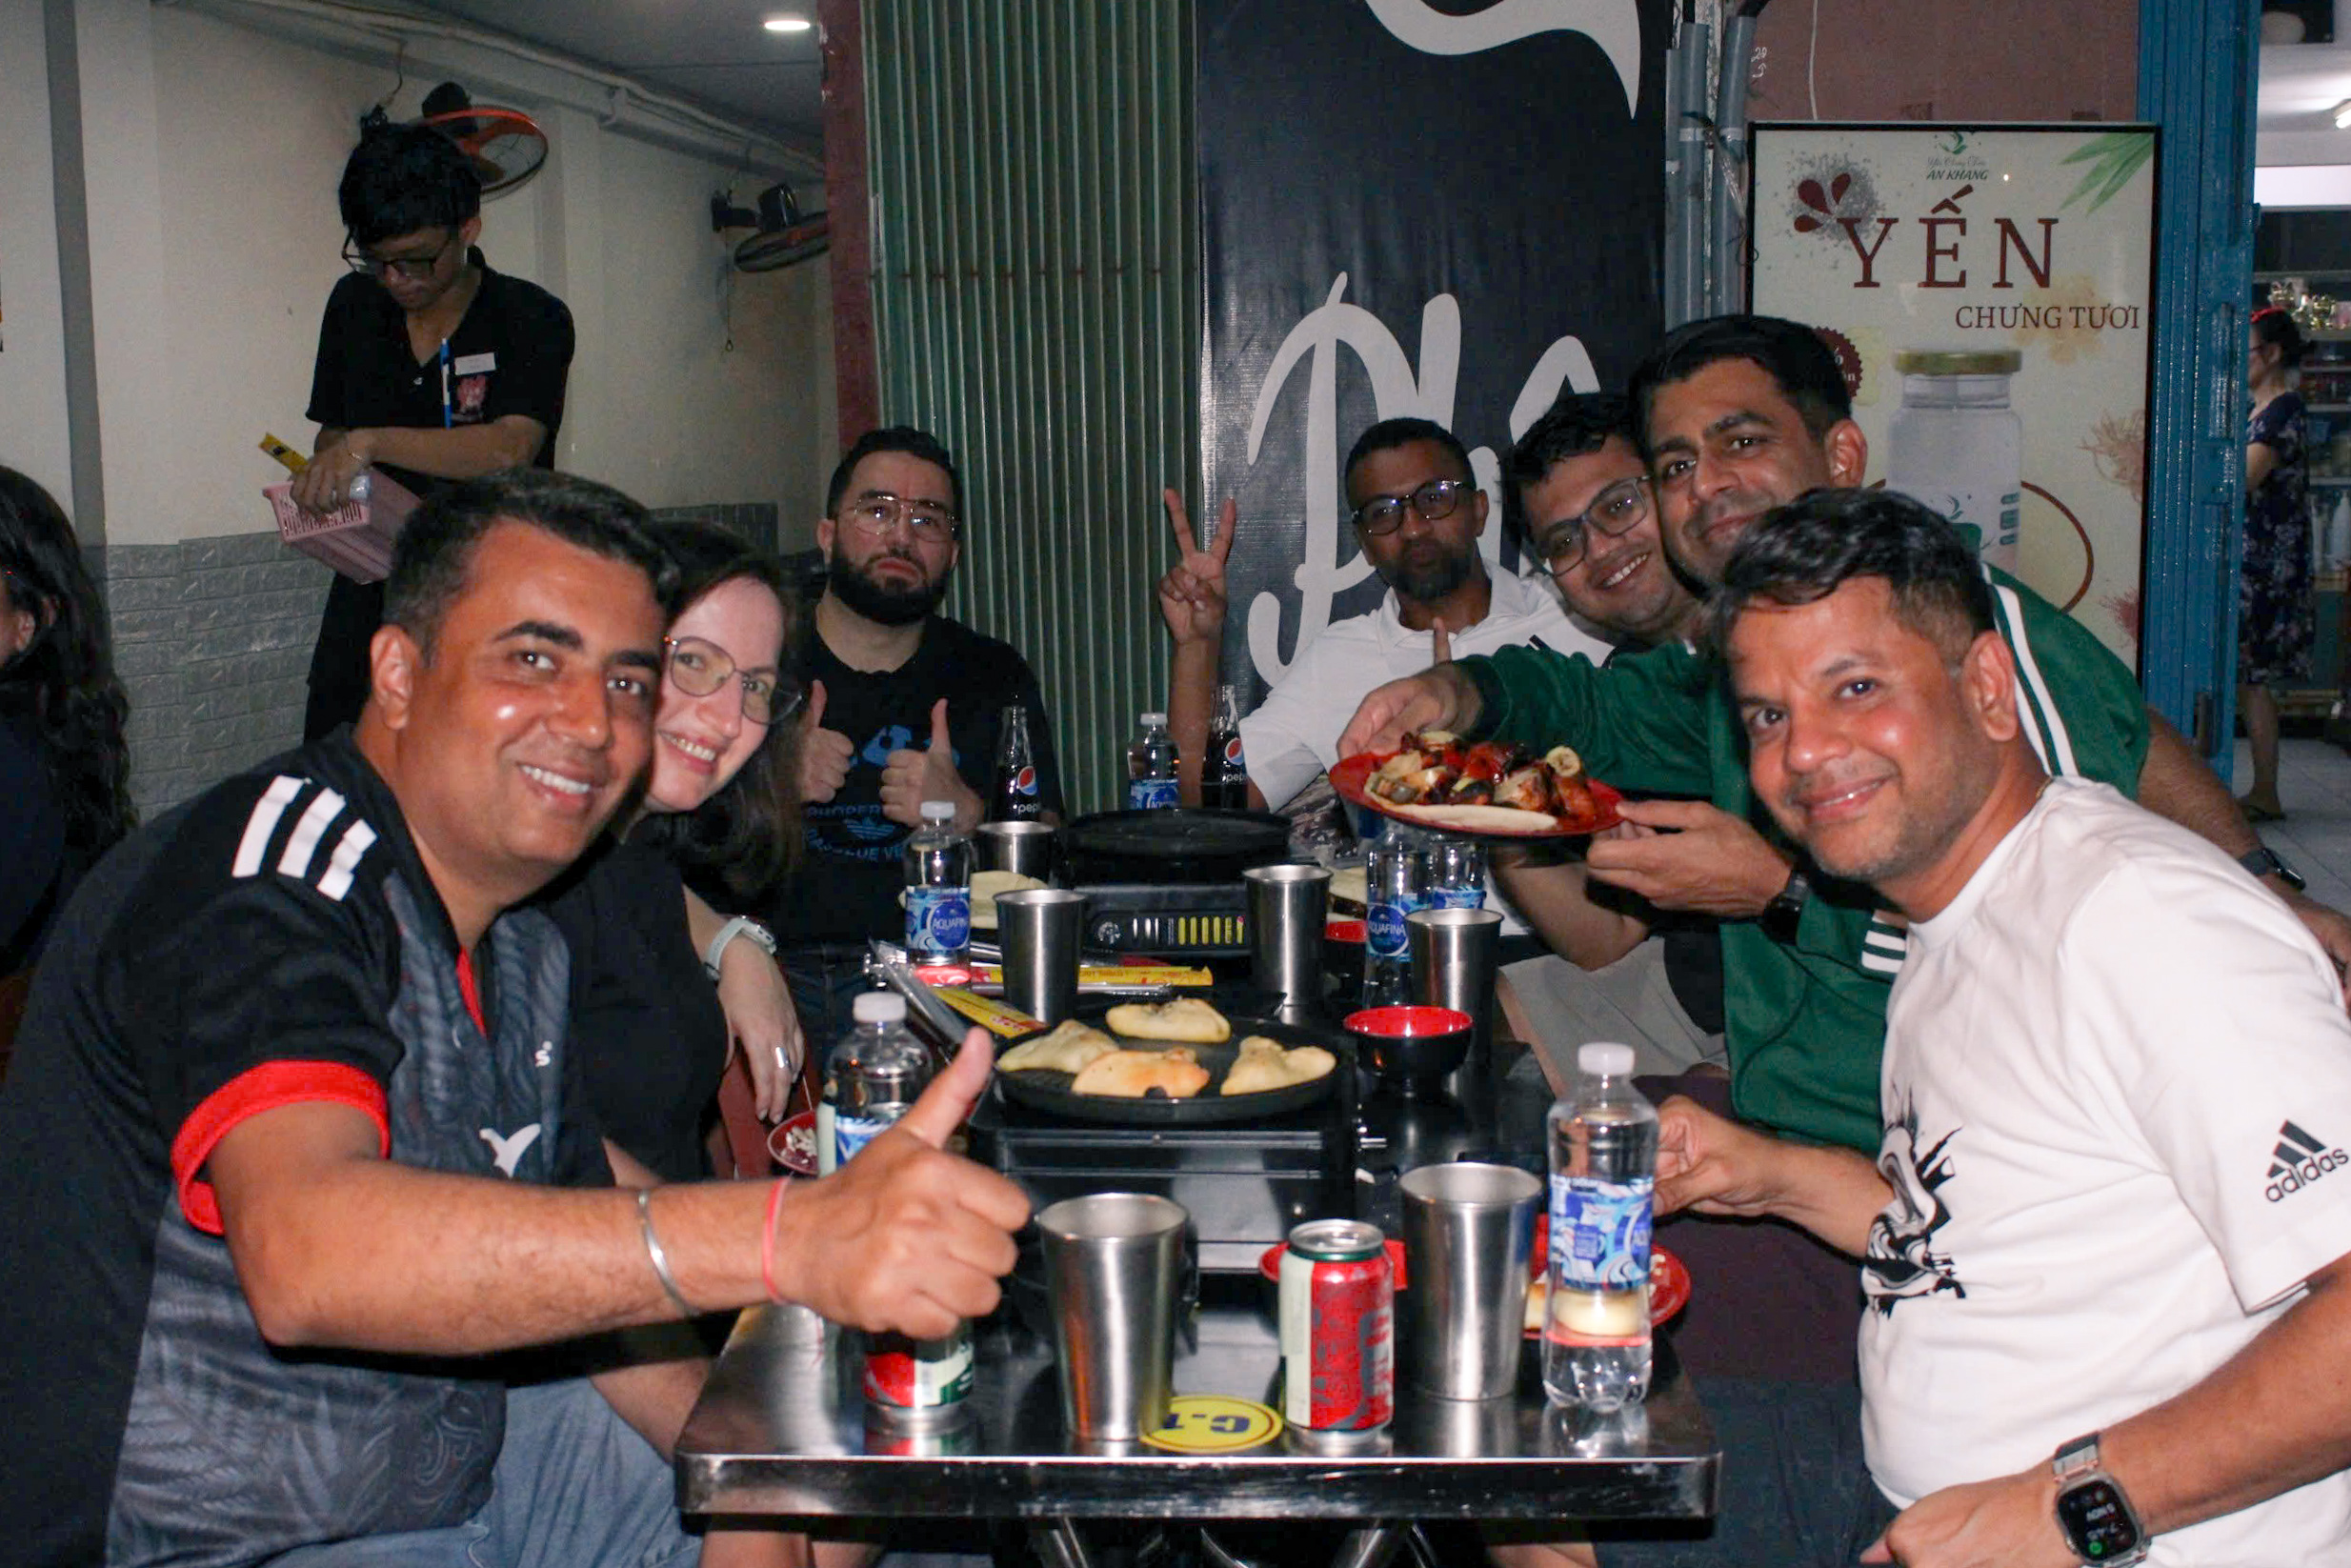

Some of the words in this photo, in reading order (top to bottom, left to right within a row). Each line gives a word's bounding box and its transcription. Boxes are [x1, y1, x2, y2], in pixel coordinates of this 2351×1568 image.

[1946, 170, 1989, 181] KHANG
[1836, 184, 2060, 289] YẾN
[1955, 303, 2062, 330] CHƯNG
[2068, 303, 2140, 330] TƯƠI
[2265, 1148, 2349, 1202] adidas
